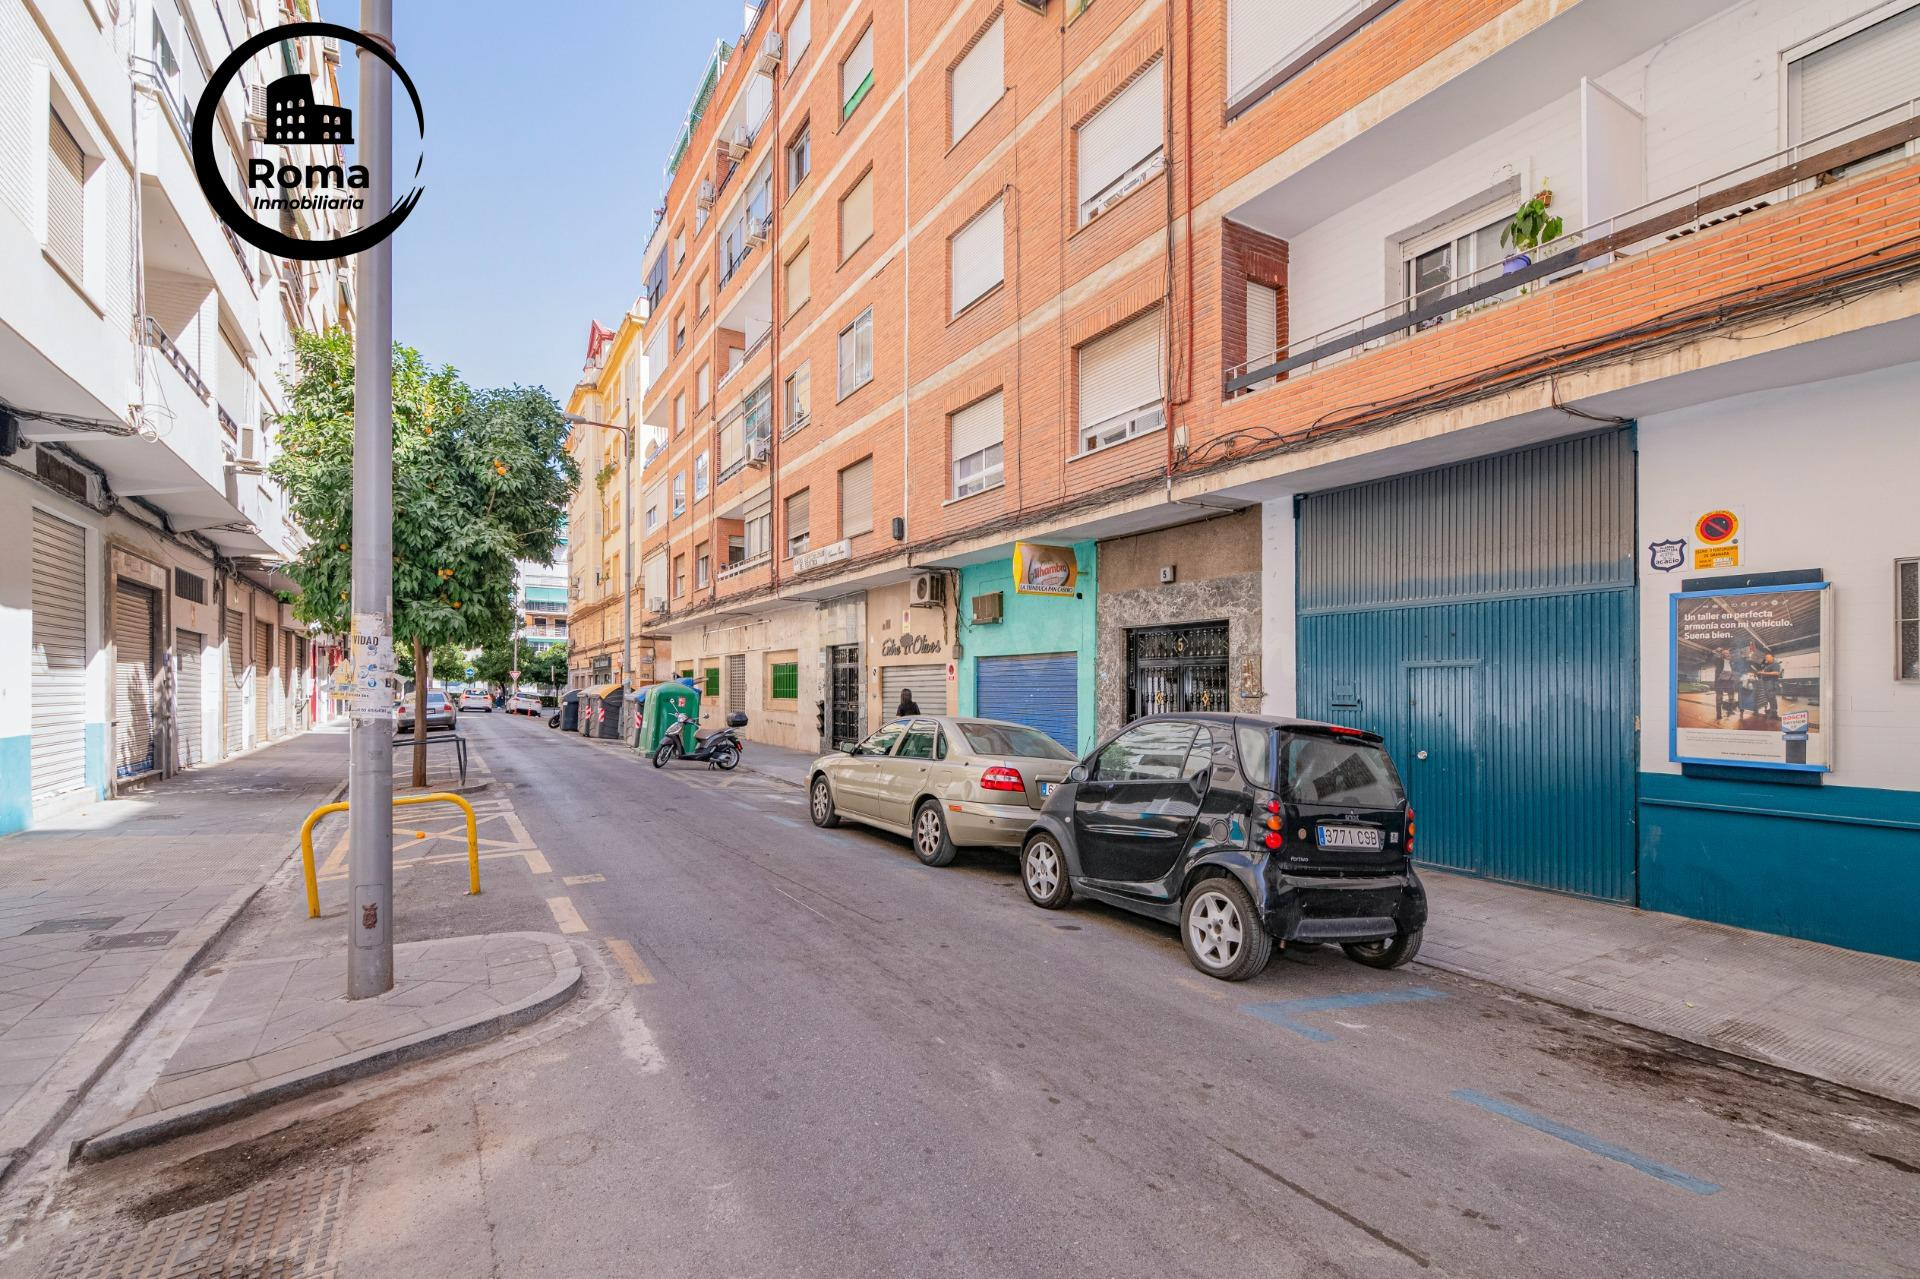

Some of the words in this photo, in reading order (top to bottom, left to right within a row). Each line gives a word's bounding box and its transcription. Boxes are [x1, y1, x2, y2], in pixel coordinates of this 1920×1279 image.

[1162, 570, 1167, 578] 5
[1684, 613, 1696, 621] Un
[1697, 612, 1720, 620] taller
[1734, 610, 1773, 620] perfecta
[1684, 622, 1719, 630] armonía
[1751, 619, 1793, 628] vehículo.
[1684, 632, 1710, 640] Suena
[1711, 631, 1733, 639] bien.
[1177, 638, 1184, 652] 5
[1325, 829, 1354, 844] 3771
